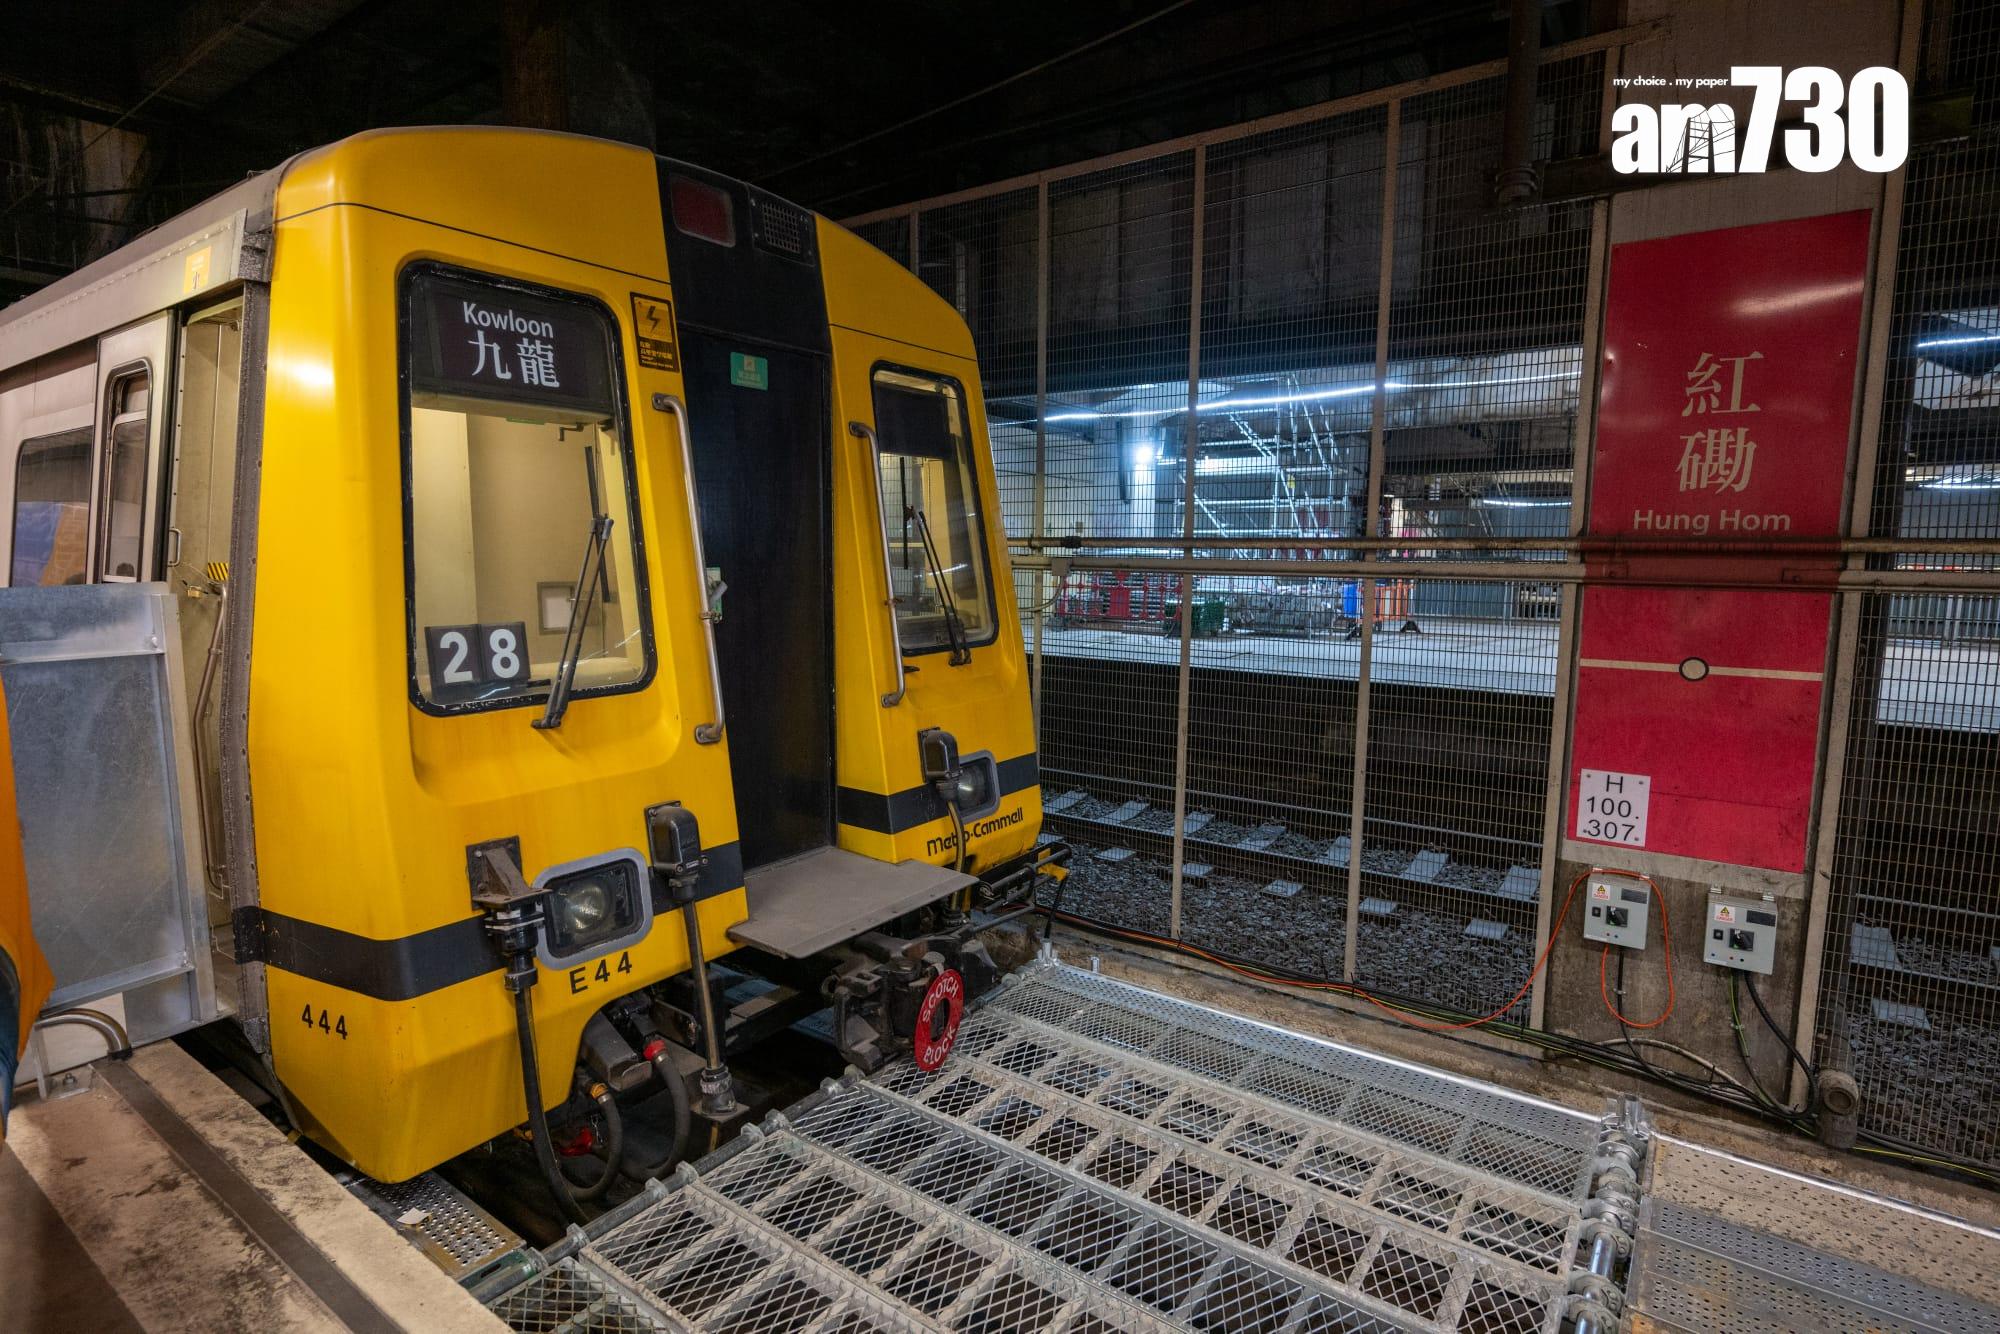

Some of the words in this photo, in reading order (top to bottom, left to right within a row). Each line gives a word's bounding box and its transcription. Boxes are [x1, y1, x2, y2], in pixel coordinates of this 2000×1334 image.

[463, 301, 554, 339] Kowloon
[467, 329, 560, 388] 九龍
[1675, 350, 1764, 495] 紅磡
[1633, 509, 1710, 536] Hung
[1719, 509, 1791, 531] Hom
[1605, 774, 1623, 794] H
[1587, 819, 1636, 841] 307
[569, 951, 633, 995] E44
[922, 976, 959, 1023] SCOTCH
[301, 1003, 348, 1040] 444
[923, 1024, 957, 1065] BLOCK
